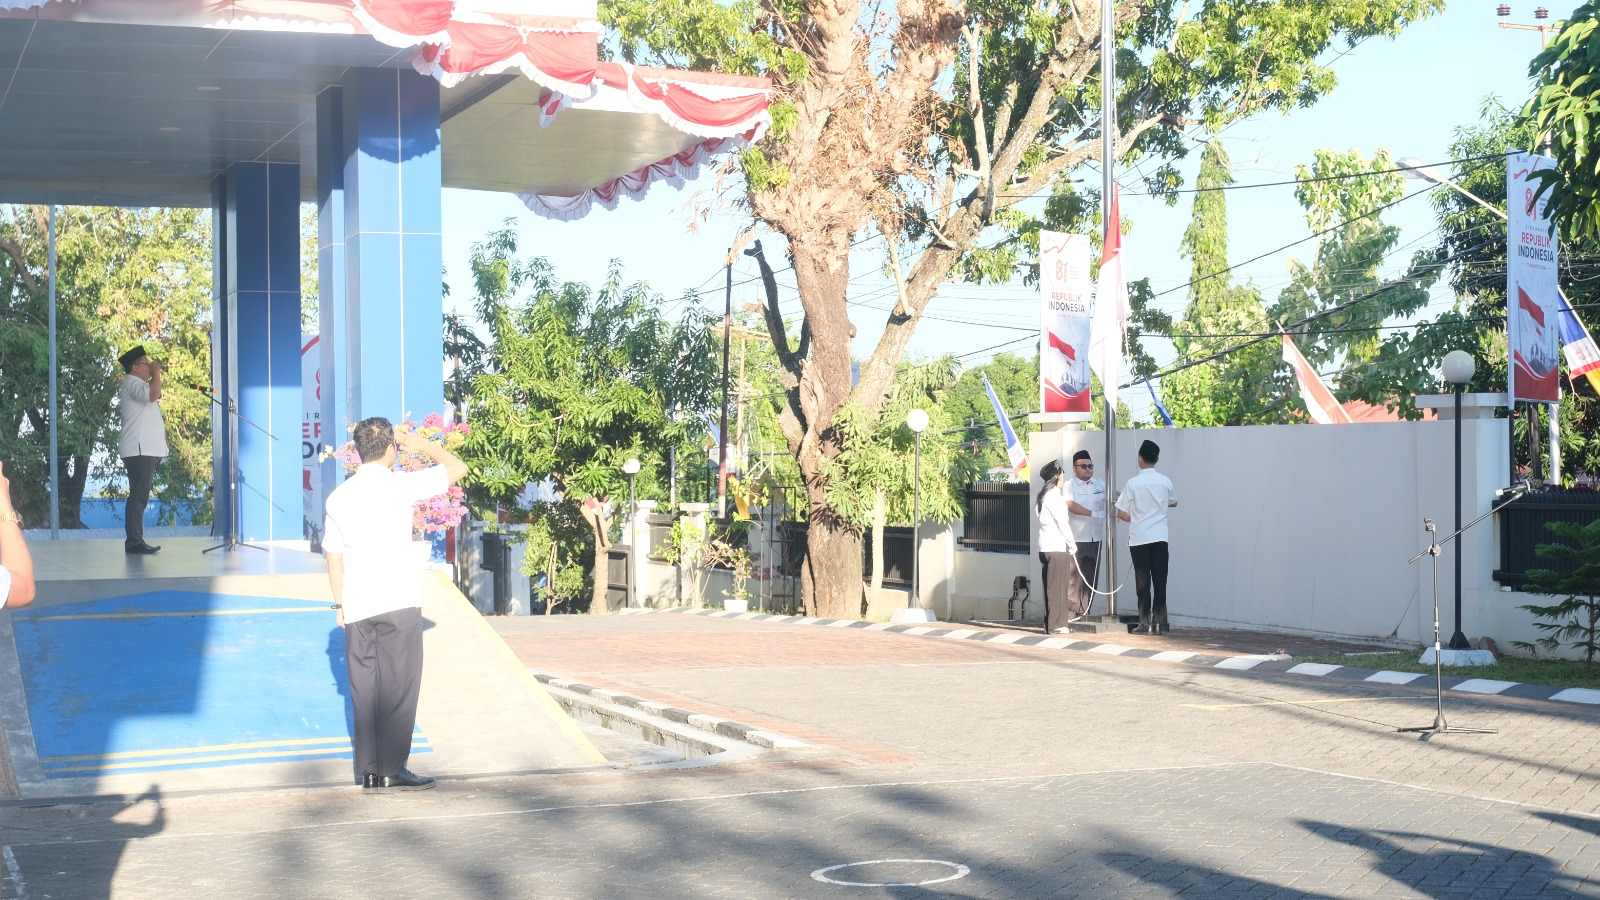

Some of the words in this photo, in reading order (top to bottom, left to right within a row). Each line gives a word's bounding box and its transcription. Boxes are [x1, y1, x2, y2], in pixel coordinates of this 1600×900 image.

[1521, 232, 1552, 248] REPUBLIK
[1518, 244, 1554, 261] INDONESIA
[1048, 301, 1085, 312] INDONESIA
